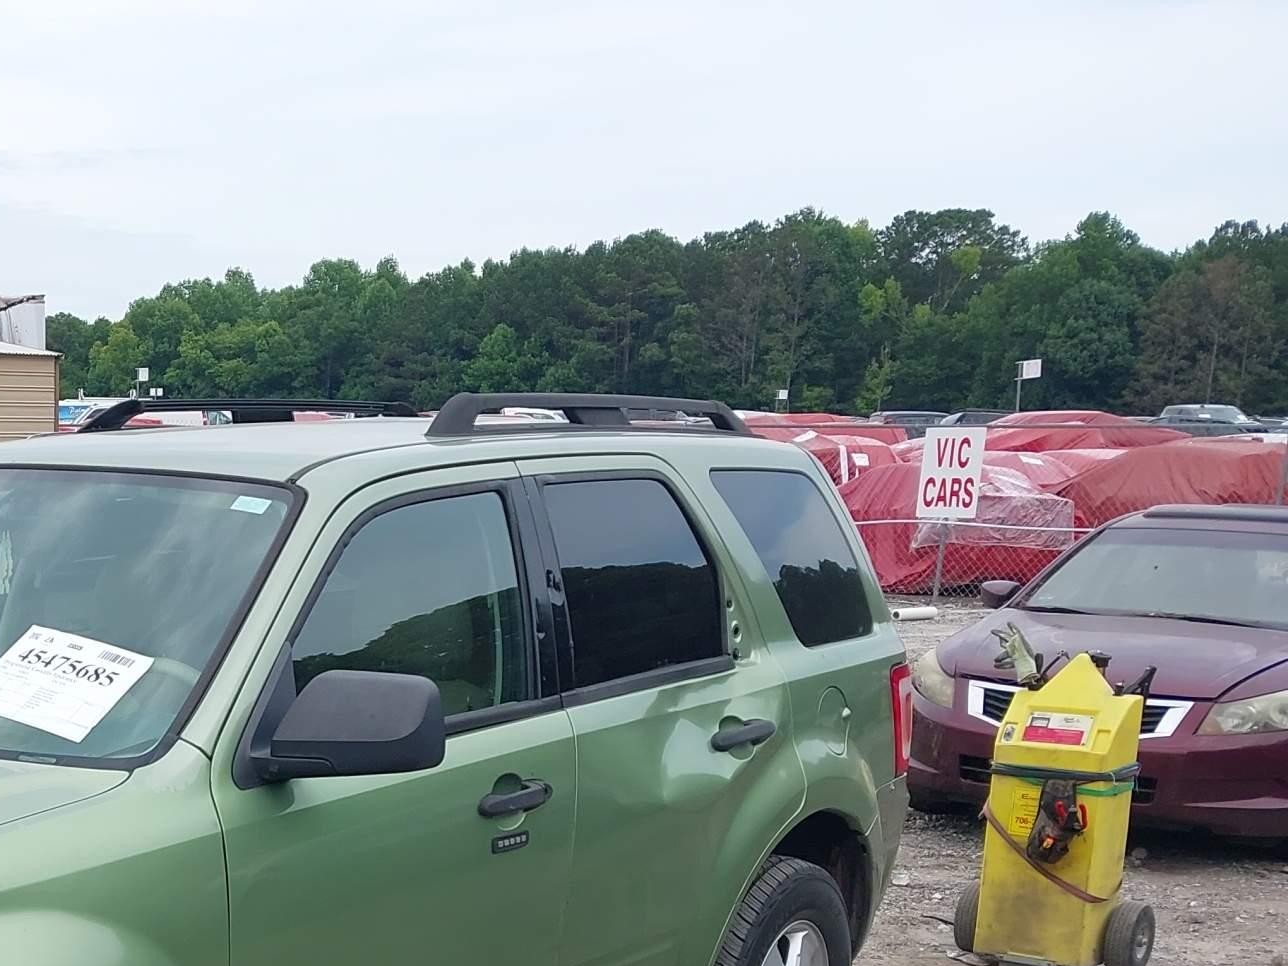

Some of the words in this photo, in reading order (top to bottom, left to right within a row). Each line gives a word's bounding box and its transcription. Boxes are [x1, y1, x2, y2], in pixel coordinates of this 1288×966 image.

[936, 437, 972, 468] VIC
[923, 477, 974, 508] CARS
[18, 647, 121, 687] 45475685
